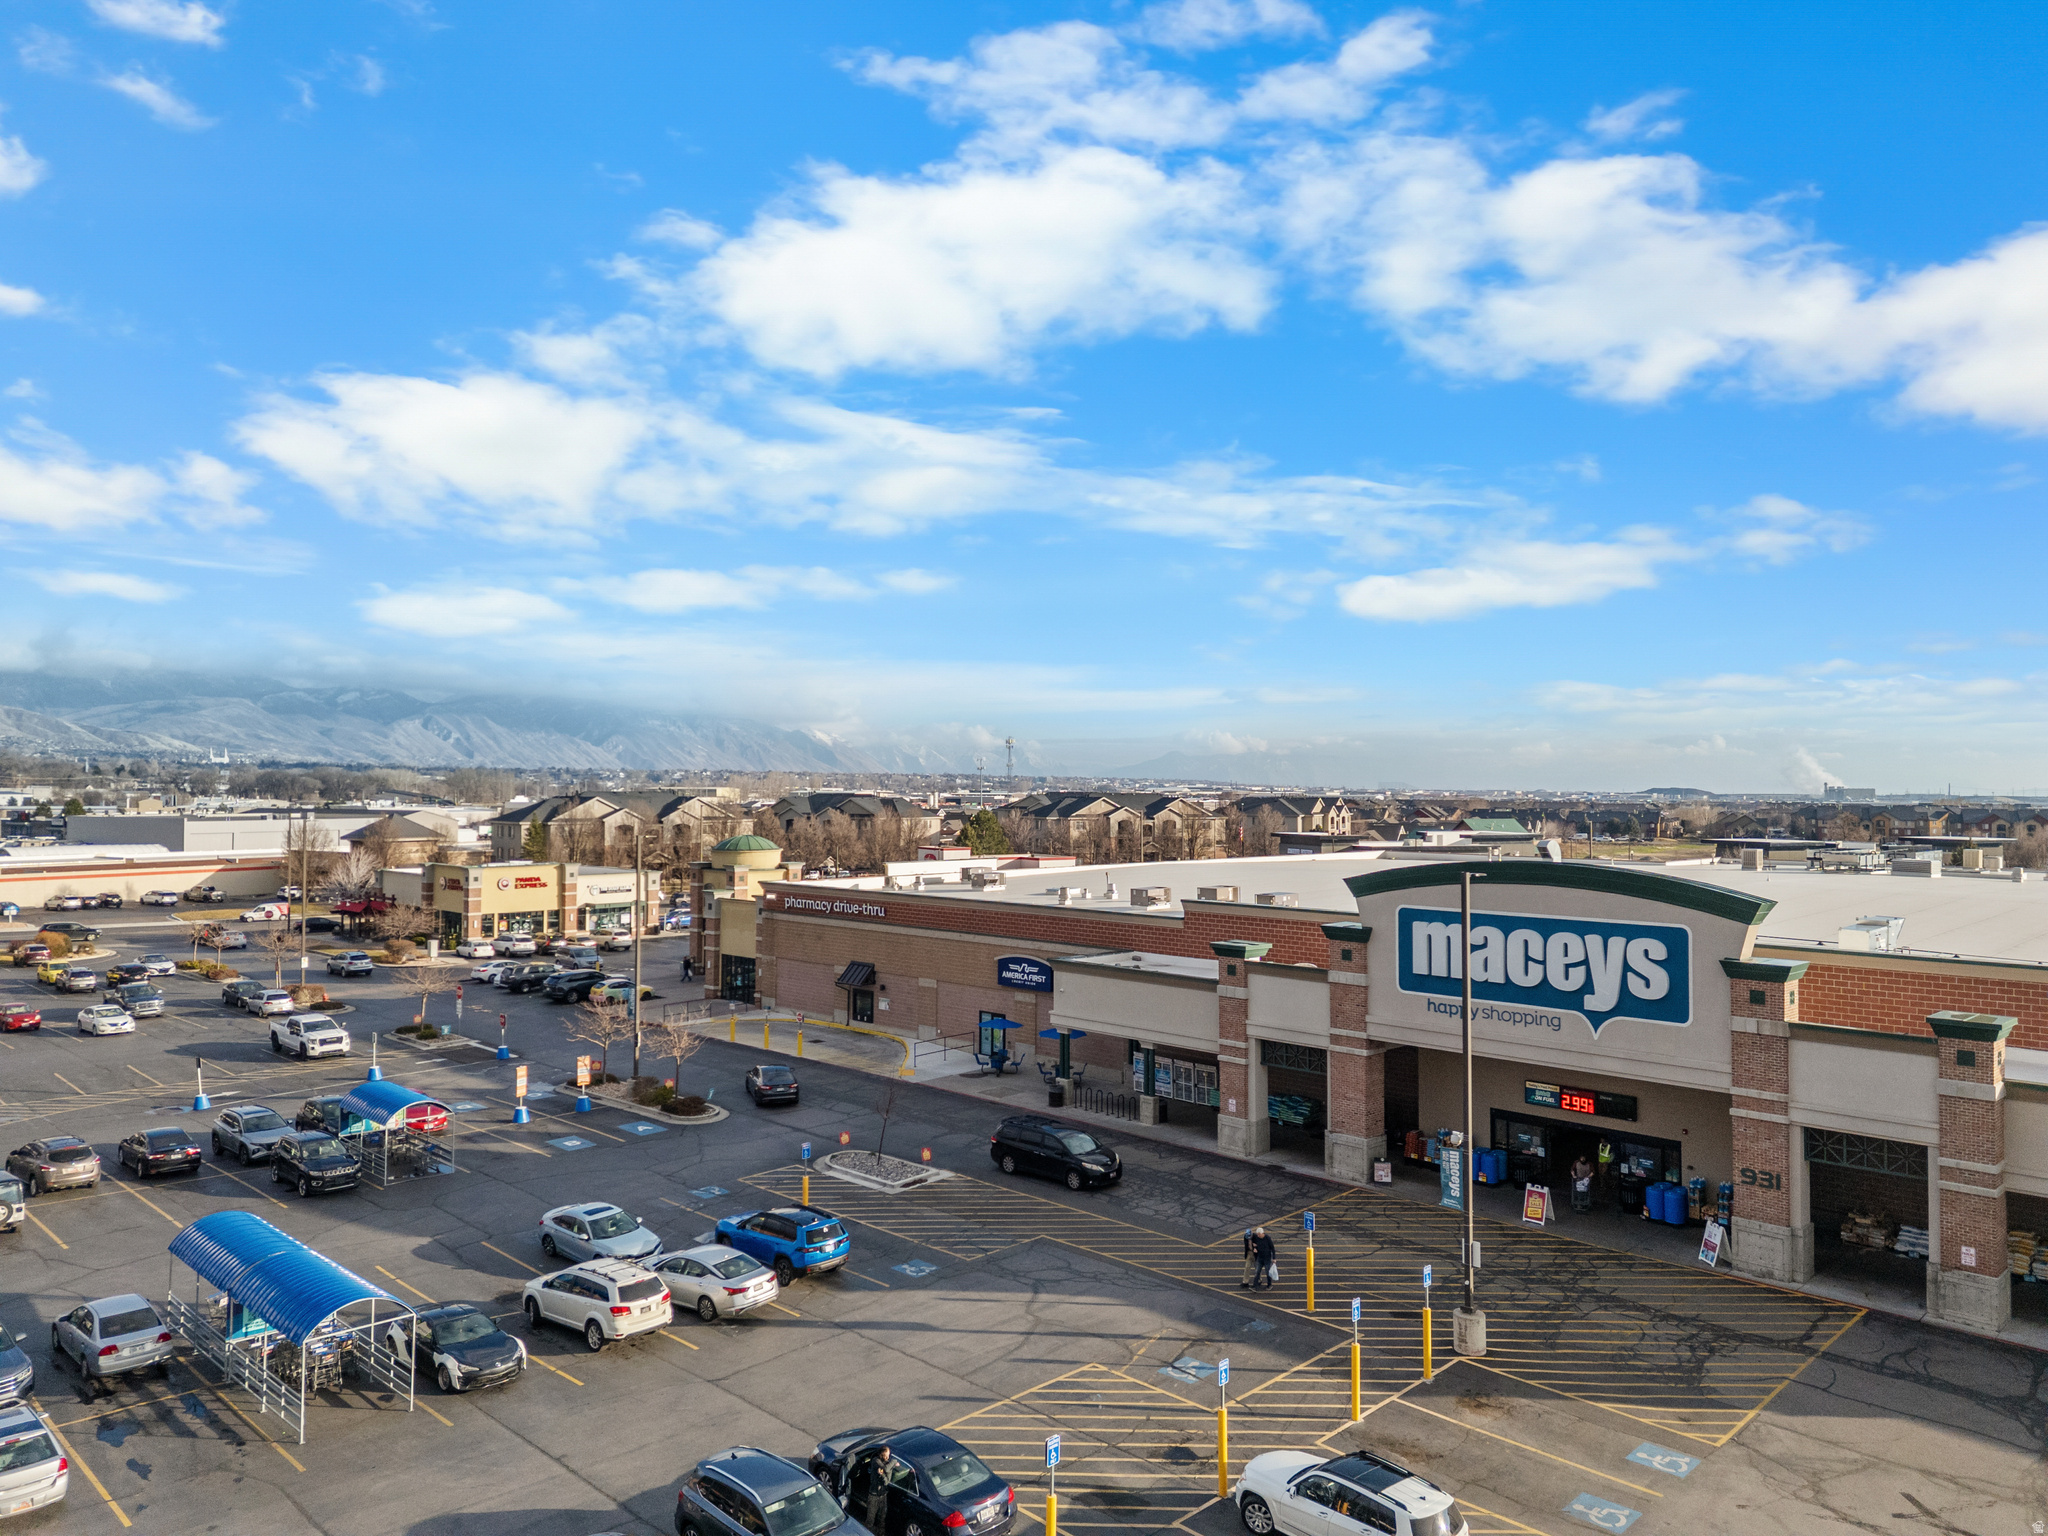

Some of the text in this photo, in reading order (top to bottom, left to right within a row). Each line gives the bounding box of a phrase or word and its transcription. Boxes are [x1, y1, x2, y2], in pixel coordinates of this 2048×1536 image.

[785, 896, 885, 916] pharmacy drive-thru
[1002, 971, 1046, 983] AMERICA FIRST
[1412, 920, 1671, 1012] maceys
[1427, 998, 1562, 1031] hapy shopping
[1449, 1150, 1460, 1198] maceys
[1740, 1168, 1782, 1191] 931
